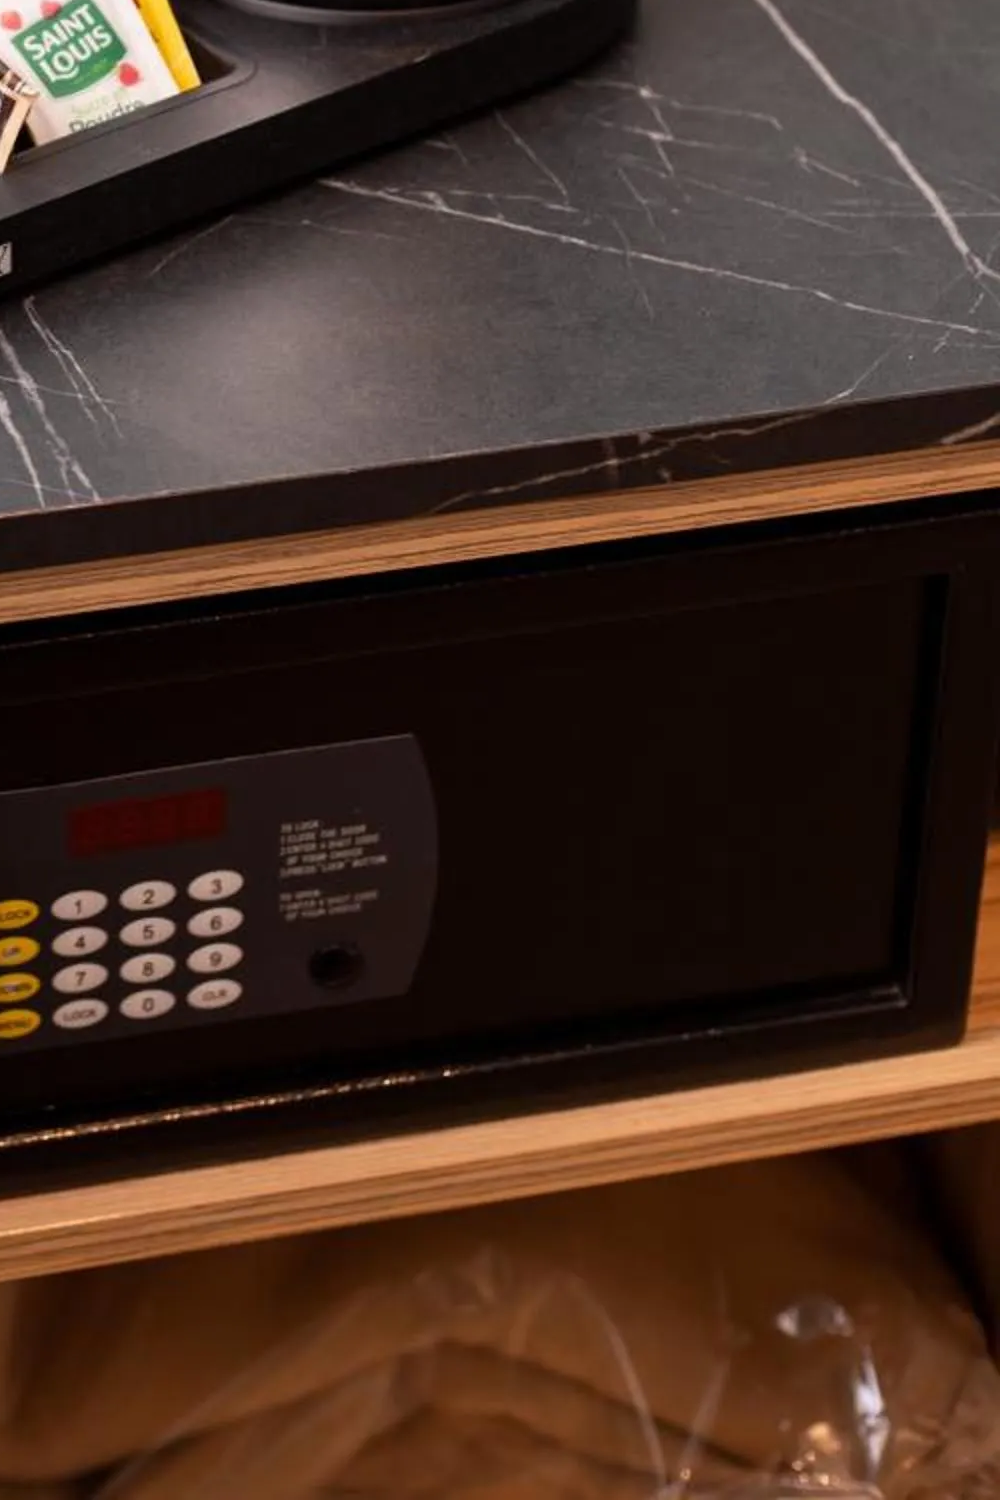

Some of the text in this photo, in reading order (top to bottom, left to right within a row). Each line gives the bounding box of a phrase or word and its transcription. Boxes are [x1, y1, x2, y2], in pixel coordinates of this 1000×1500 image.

[23, 3, 95, 61] SAINT
[39, 25, 112, 82] LOUIS
[211, 878, 223, 894] 3
[143, 889, 155, 905] 2
[210, 915, 222, 931] 6
[143, 924, 155, 941] 5
[73, 935, 86, 949] 4
[209, 951, 222, 967] 9
[142, 961, 154, 977] 8
[75, 971, 87, 987] 7
[142, 997, 154, 1013] 0
